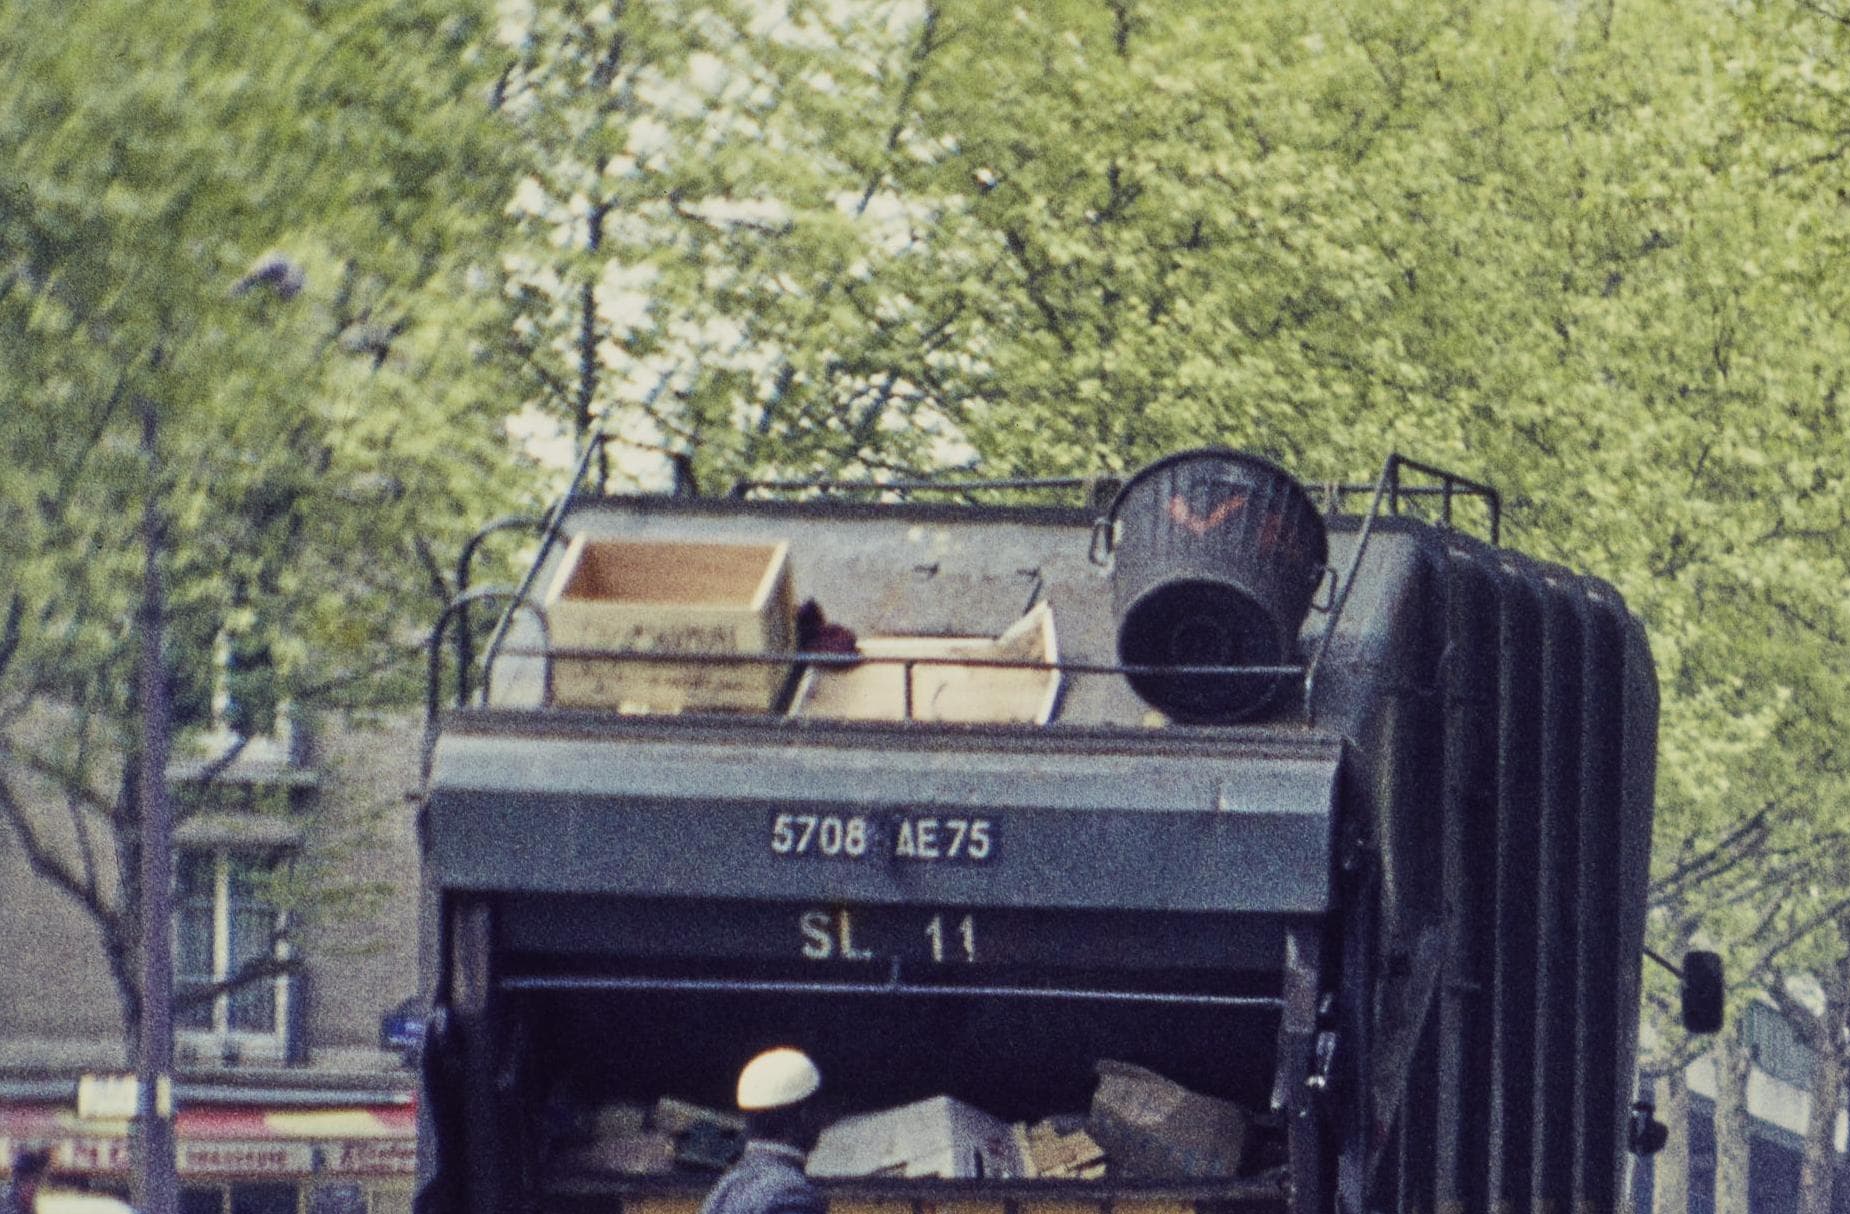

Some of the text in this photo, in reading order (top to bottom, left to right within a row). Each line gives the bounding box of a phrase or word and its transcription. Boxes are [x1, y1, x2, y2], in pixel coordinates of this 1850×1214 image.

[771, 813, 867, 857] 5708
[800, 909, 976, 963] SL 11
